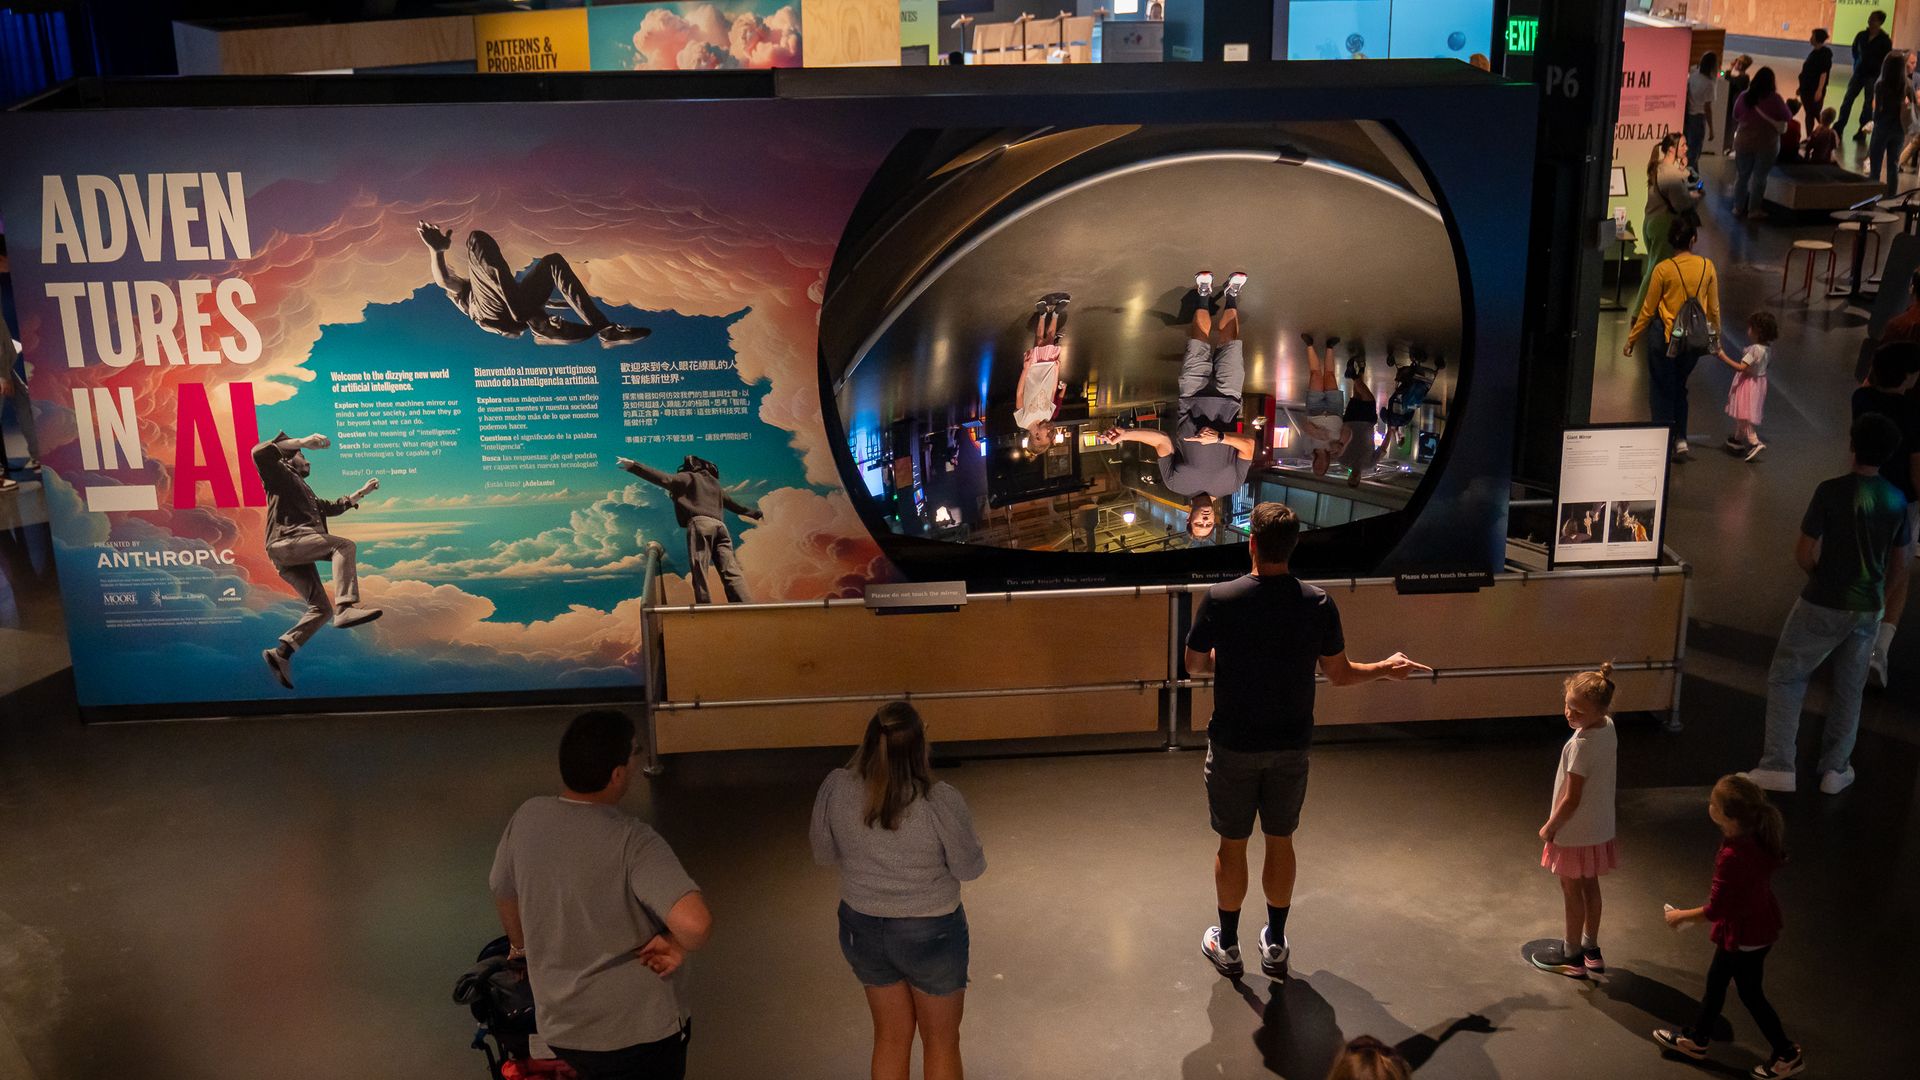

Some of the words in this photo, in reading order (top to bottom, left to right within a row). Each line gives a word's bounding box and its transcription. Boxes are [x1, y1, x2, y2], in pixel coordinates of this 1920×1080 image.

[1509, 21, 1538, 51] EXIT
[487, 37, 540, 57] PATTERNS
[544, 37, 551, 52] &
[488, 53, 557, 72] PROBABILITY
[1546, 65, 1579, 98] P6
[1638, 71, 1651, 88] AI
[1637, 124, 1653, 140] LA
[41, 172, 251, 264] ADVEN
[46, 279, 263, 368] TURES
[331, 372, 362, 381] Welcome
[364, 372, 370, 381] to
[372, 371, 384, 380] the
[385, 370, 413, 381] dizzying
[430, 369, 449, 378] world
[474, 367, 516, 377] Bienvenido
[517, 367, 524, 375] al
[525, 367, 548, 375] nuevo
[548, 367, 553, 376] y
[554, 366, 596, 375] vertiginoso
[332, 384, 340, 392] of
[341, 383, 370, 392] artificial
[372, 382, 413, 393] intelligence.
[475, 379, 501, 387] mundo
[502, 378, 510, 387] de
[512, 378, 519, 386] la
[520, 377, 564, 387] inteligencia
[565, 376, 599, 385] artificial.
[72, 387, 144, 471] IN
[173, 382, 267, 510] AI
